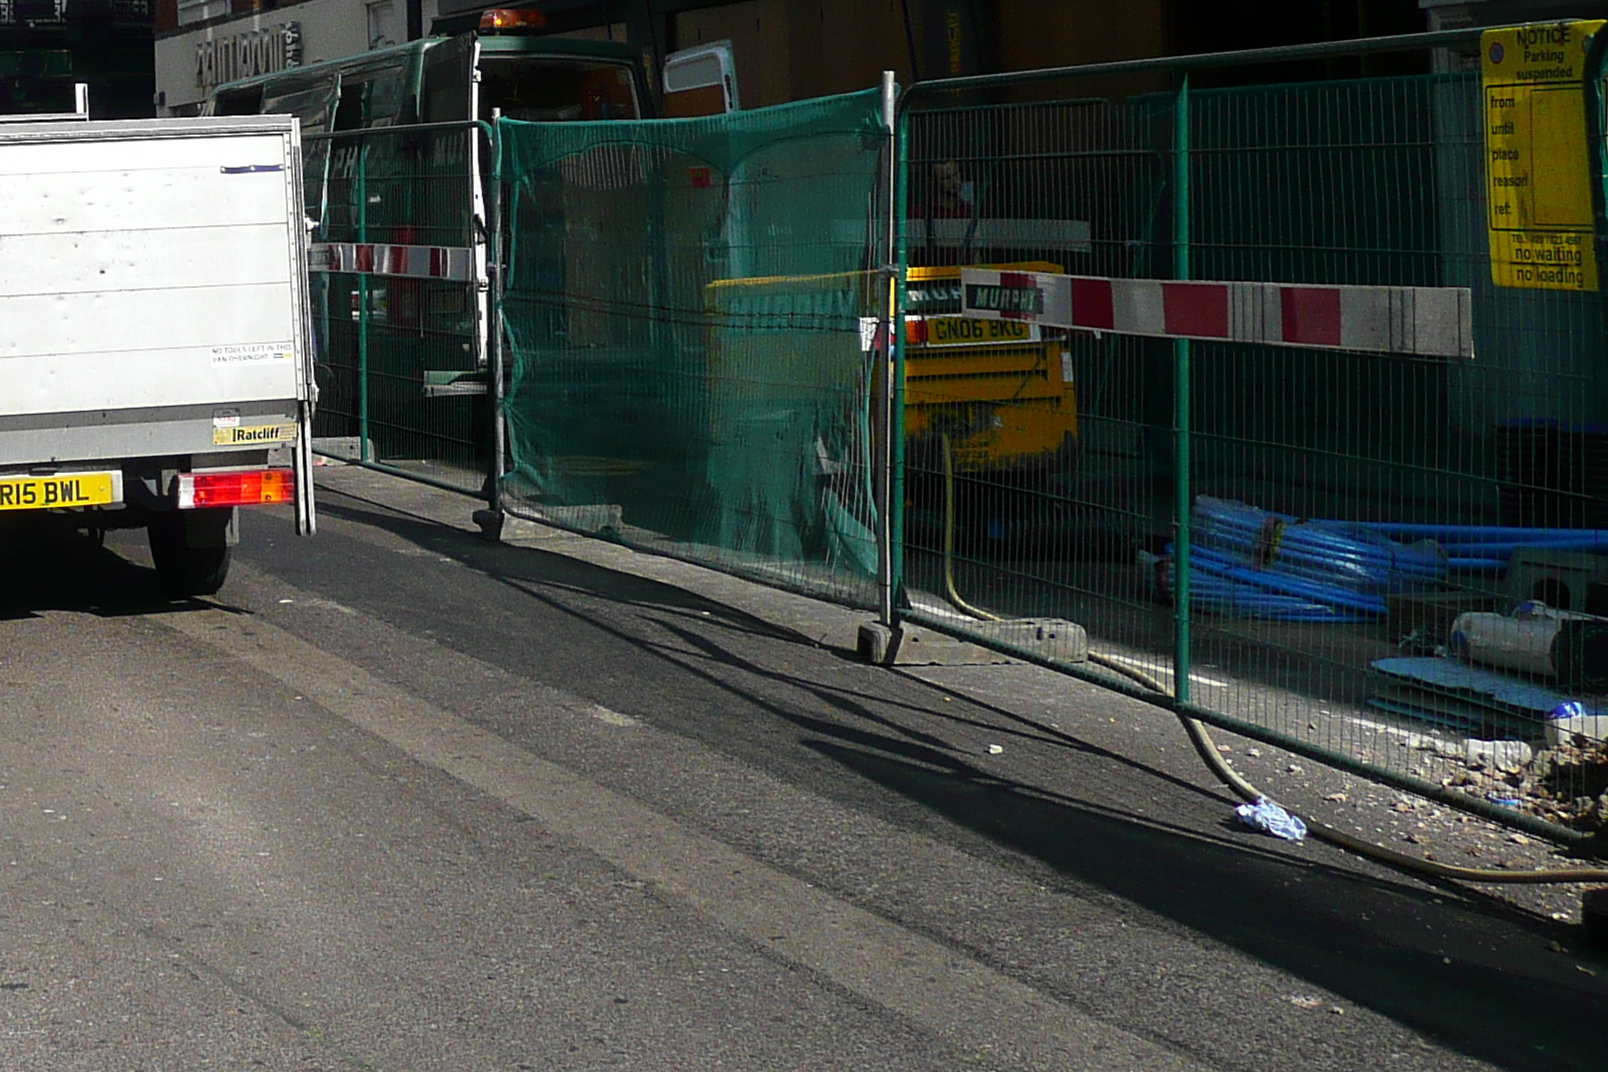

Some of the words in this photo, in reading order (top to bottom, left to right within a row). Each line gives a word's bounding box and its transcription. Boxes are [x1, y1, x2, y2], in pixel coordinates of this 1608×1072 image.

[1517, 26, 1570, 46] NOTICE
[1523, 50, 1565, 64] Parking
[1516, 67, 1573, 81] suspended
[1491, 95, 1515, 108] from
[1492, 121, 1514, 135] until
[1492, 149, 1520, 163] place
[1494, 176, 1528, 187] reason
[1495, 202, 1512, 215] ref:
[1515, 247, 1531, 260] no
[1535, 246, 1583, 267] waiting
[1517, 268, 1533, 281] no
[1536, 266, 1584, 288] loading
[976, 287, 1036, 311] MURPHY
[237, 427, 280, 441] Ratcliff
[0, 483, 36, 505] R15
[44, 480, 89, 504] BWL
